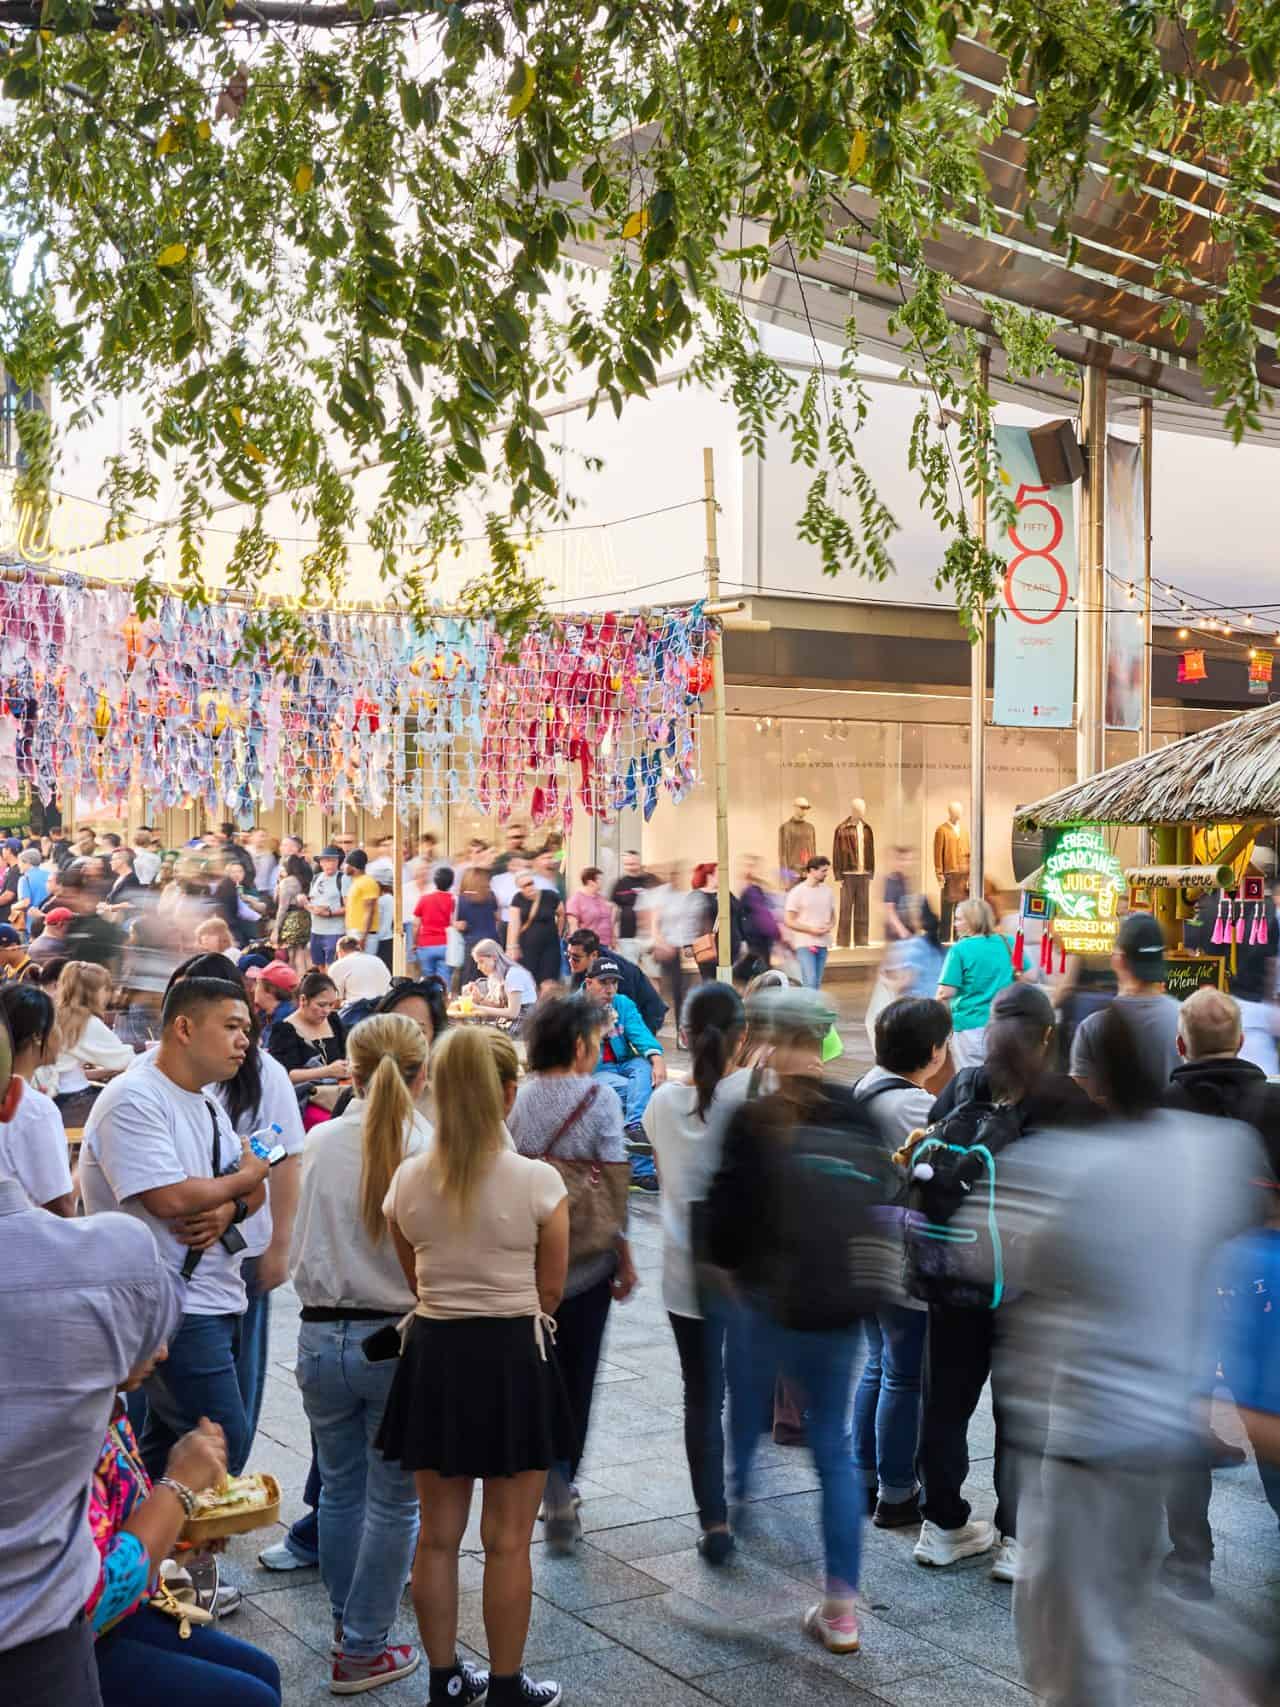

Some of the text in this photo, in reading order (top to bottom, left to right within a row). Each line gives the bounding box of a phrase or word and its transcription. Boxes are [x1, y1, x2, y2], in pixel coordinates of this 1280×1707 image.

[1023, 521, 1048, 533] FIFTY
[1061, 832, 1103, 850] FRESH
[1046, 850, 1120, 876] SUGARCANE
[1062, 874, 1101, 891] JUICE
[1054, 919, 1117, 934] PRESSED ON
[1064, 936, 1111, 952] THE SPOT
[1168, 975, 1199, 990] Menu
